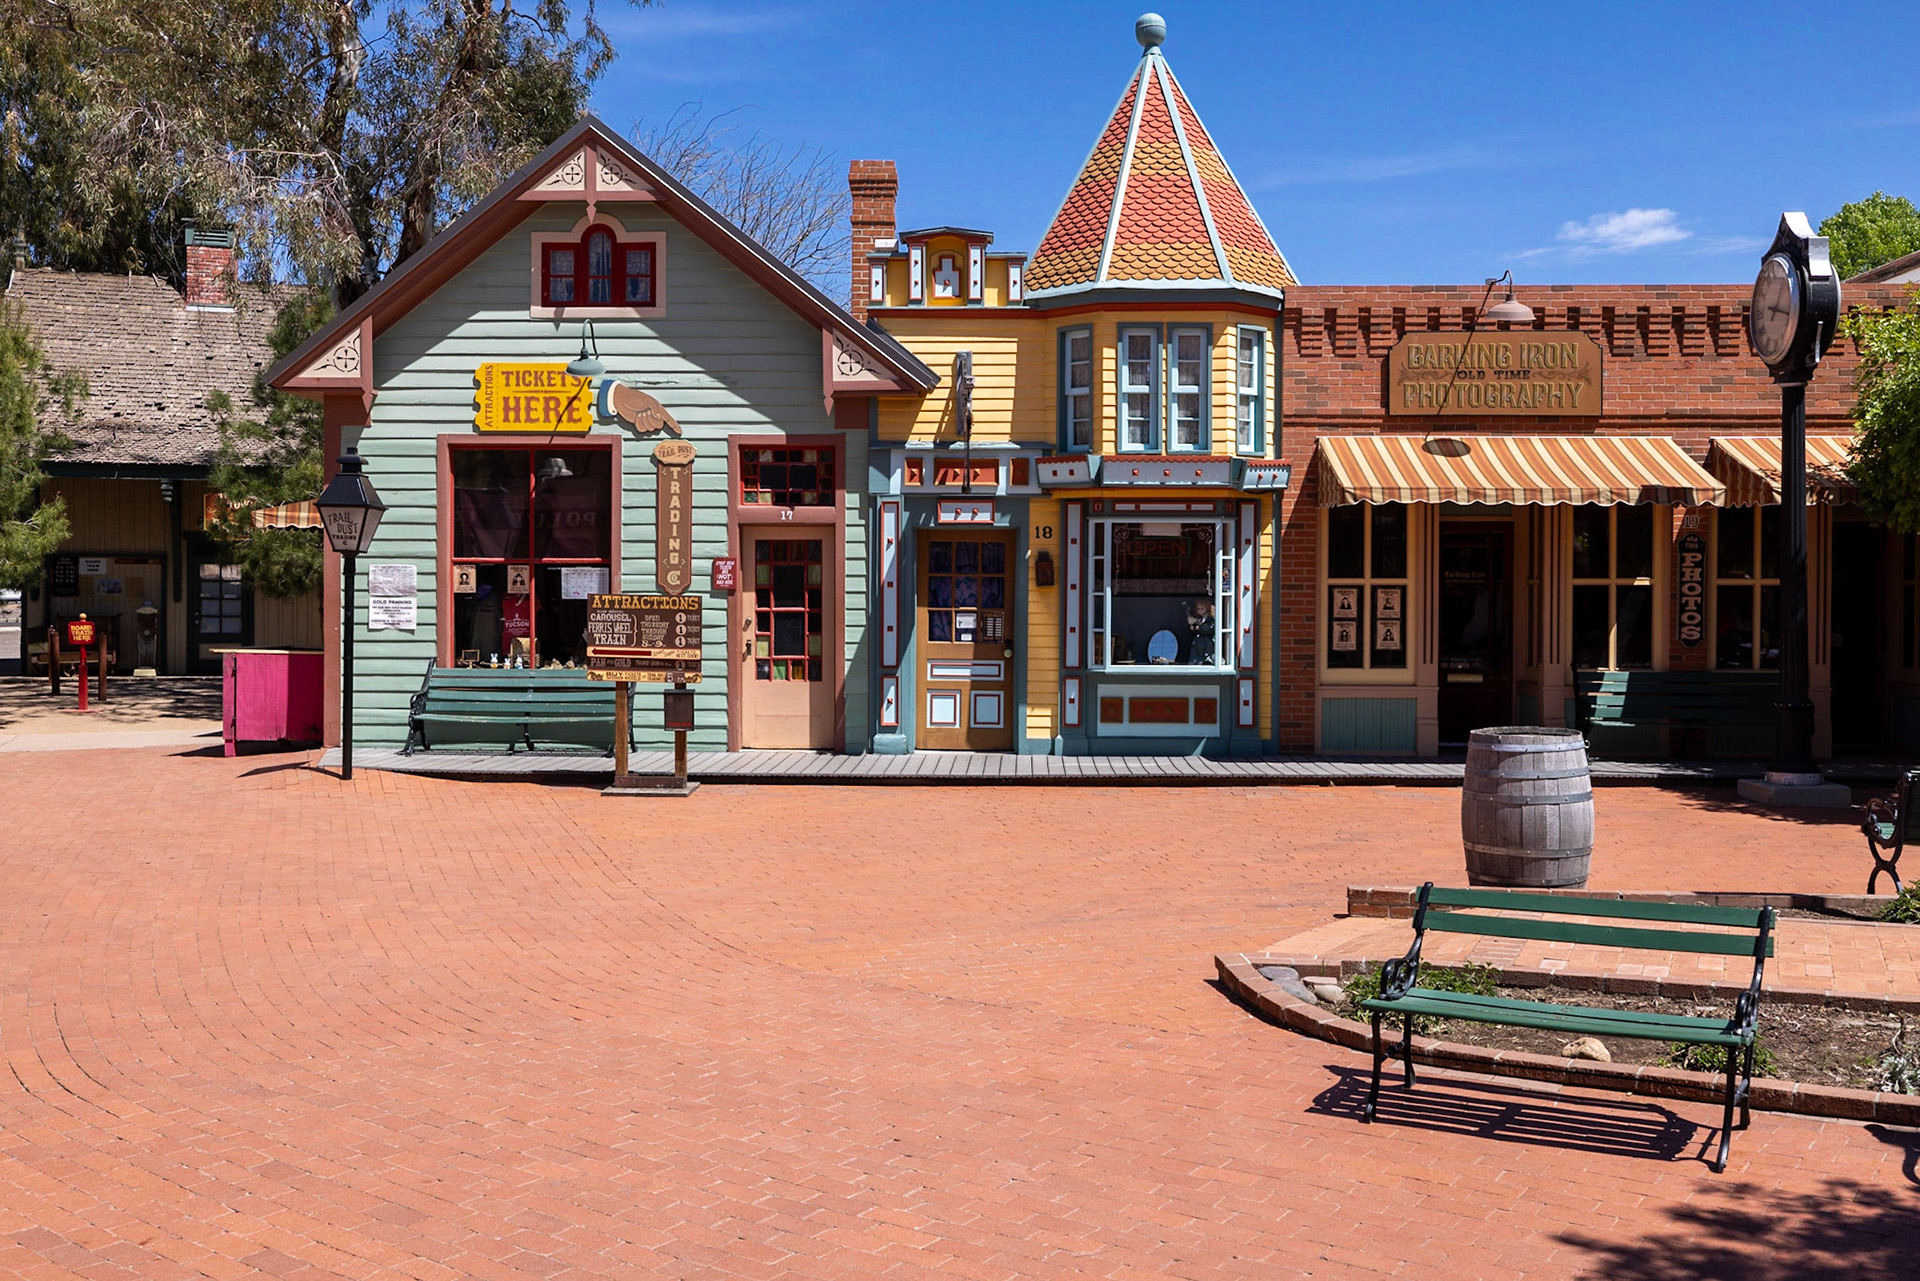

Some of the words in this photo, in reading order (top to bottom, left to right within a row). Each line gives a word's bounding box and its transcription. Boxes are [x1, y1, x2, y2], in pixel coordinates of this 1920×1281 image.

[1407, 342, 1512, 369] BARKING
[1520, 342, 1579, 369] IRON
[501, 370, 582, 387] TICKETS
[1456, 370, 1486, 380] OLD
[1493, 370, 1531, 380] TIME
[484, 364, 493, 427] ATTRACTIONS
[1403, 382, 1585, 409] PHOTOGRAPHY
[502, 396, 582, 424] HERE
[658, 448, 676, 458] TRAIL
[678, 445, 693, 454] DUST
[327, 512, 353, 525] TRAIL
[669, 467, 681, 564] TRADING
[781, 510, 793, 520] 17
[1683, 515, 1700, 528] 19
[337, 522, 359, 534] DUST
[1035, 525, 1053, 538] 18
[1127, 541, 1186, 555] OPEN
[1681, 552, 1702, 639] PHOTOS
[592, 595, 699, 610] ATTRACTIONS
[590, 613, 631, 621] CAROUSEL
[588, 622, 612, 633] FERRIS
[613, 622, 633, 633] WHEEL
[593, 634, 626, 645] TRAIN
[590, 657, 606, 667] PAN
[614, 658, 631, 667] GOLD
